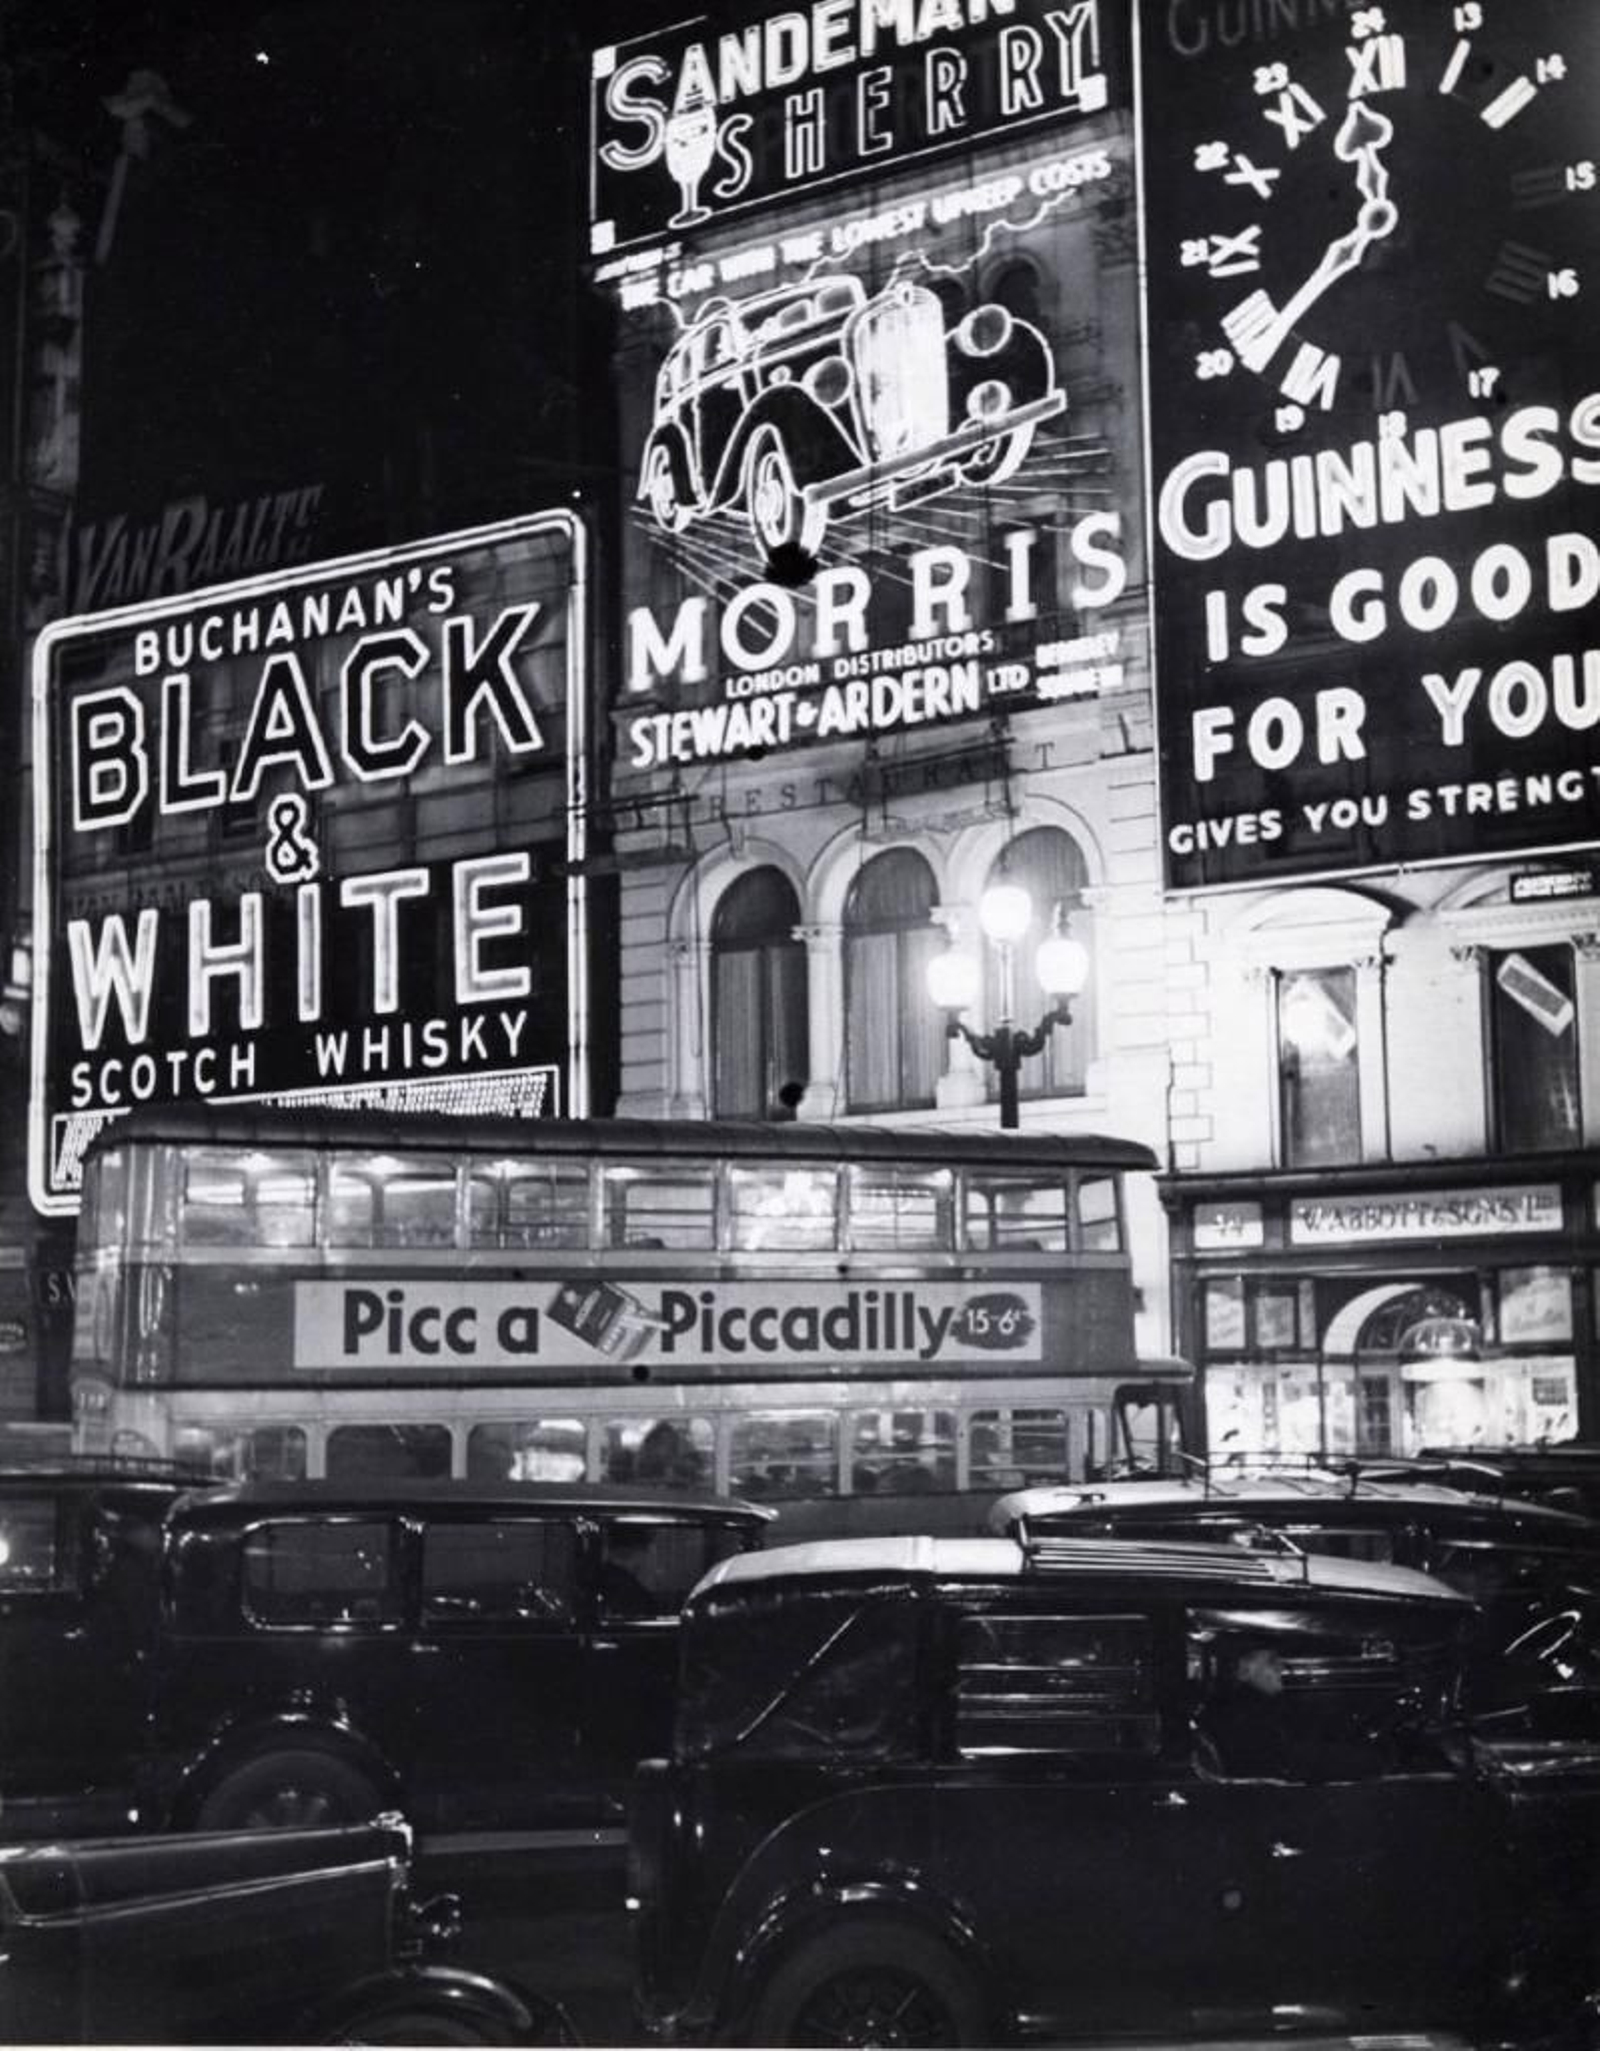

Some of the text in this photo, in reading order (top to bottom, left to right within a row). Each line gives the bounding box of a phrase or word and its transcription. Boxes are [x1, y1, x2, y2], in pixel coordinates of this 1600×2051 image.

[1350, 6, 1387, 39] 24
[1453, 2, 1484, 33] 13
[712, 2, 1094, 197] SHERRY
[1253, 62, 1289, 95] 23
[1344, 33, 1407, 100] XII
[1536, 53, 1567, 84] 14
[1262, 82, 1328, 149] XI
[1029, 150, 1113, 196] COSTS
[1224, 153, 1281, 199] X
[1565, 160, 1597, 192] 15
[1547, 268, 1580, 300] 16
[1468, 365, 1501, 399] 17
[135, 566, 457, 676] BUCHANAN'S
[627, 510, 1128, 693] MORRIS
[1205, 532, 1600, 662] IS GOOD
[725, 629, 995, 699] LONDON DISTRIBUTORS
[72, 602, 545, 833] BLACK
[630, 693, 797, 768] STEWART
[818, 661, 981, 737] ARDERN
[986, 663, 1030, 694] LTD
[1192, 650, 1600, 782] FOR YOU
[266, 793, 320, 884] &
[1168, 810, 1283, 854] GIVES
[1303, 796, 1388, 833] YOU
[66, 852, 533, 1053] WHITE
[70, 1042, 257, 1108] SCOTCH
[315, 1010, 529, 1077] WHISKY
[344, 1289, 477, 1356] Picc
[496, 1304, 539, 1355] a
[660, 1290, 955, 1360] Piccadilly
